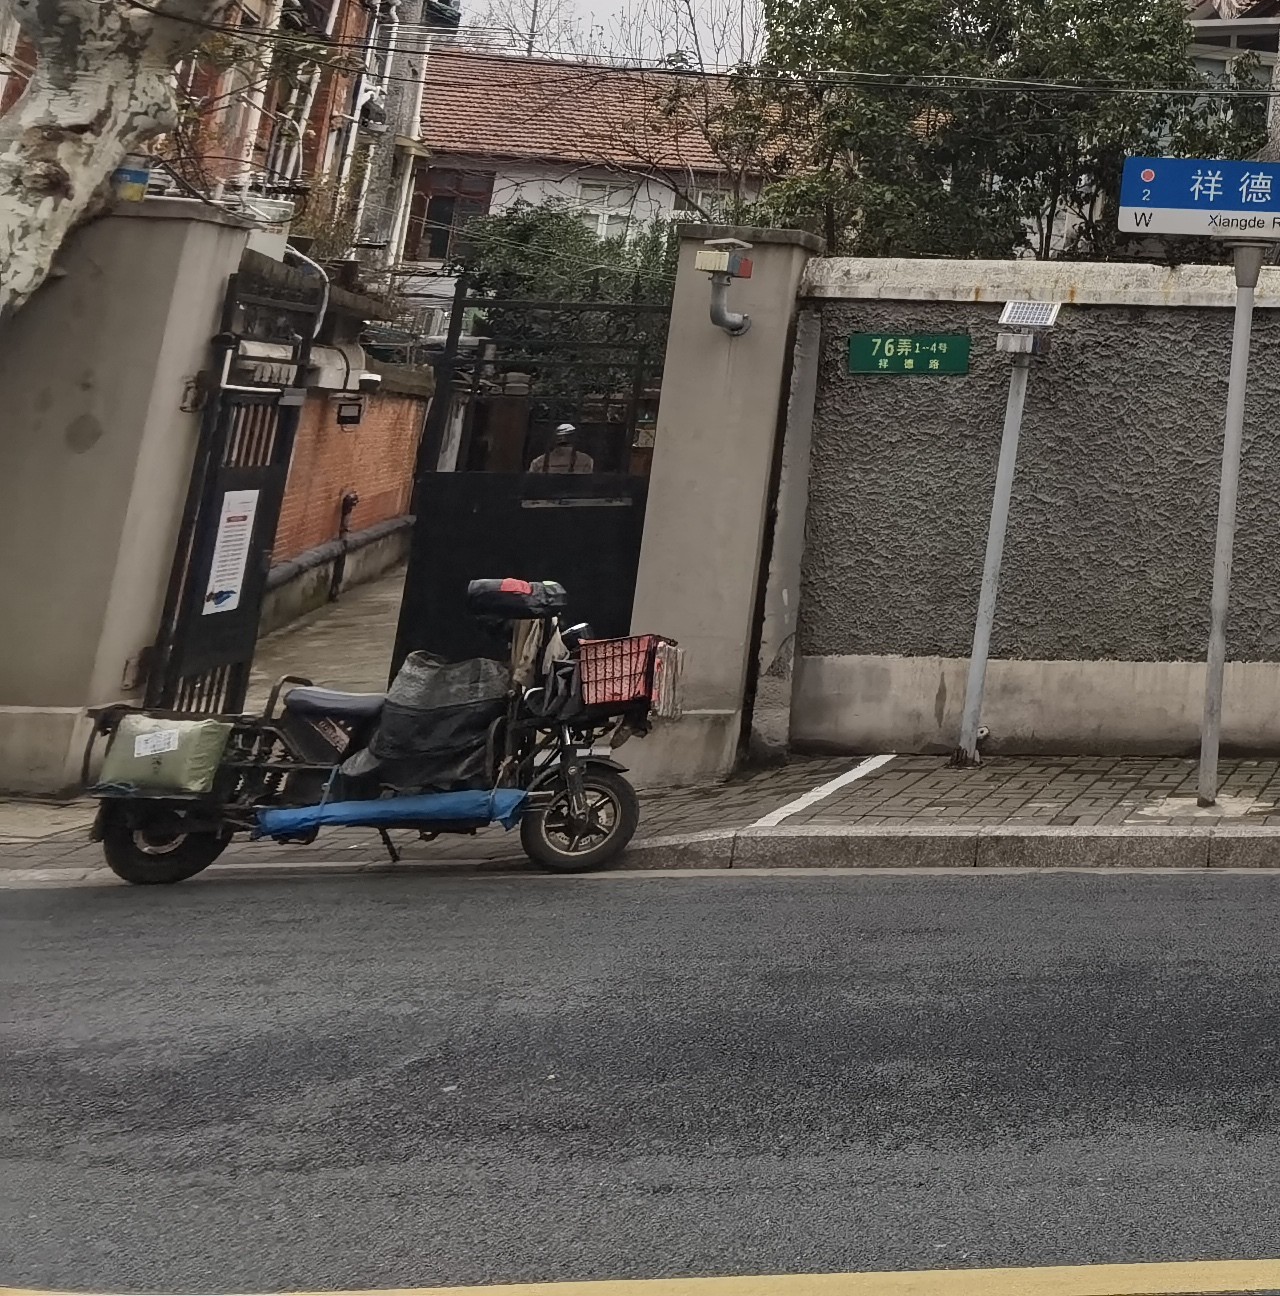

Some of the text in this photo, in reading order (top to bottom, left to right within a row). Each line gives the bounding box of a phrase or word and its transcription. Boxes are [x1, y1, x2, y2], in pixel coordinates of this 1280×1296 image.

[1141, 189, 1151, 202] 2
[1134, 211, 1153, 228] W
[1208, 214, 1265, 231] Xiangde
